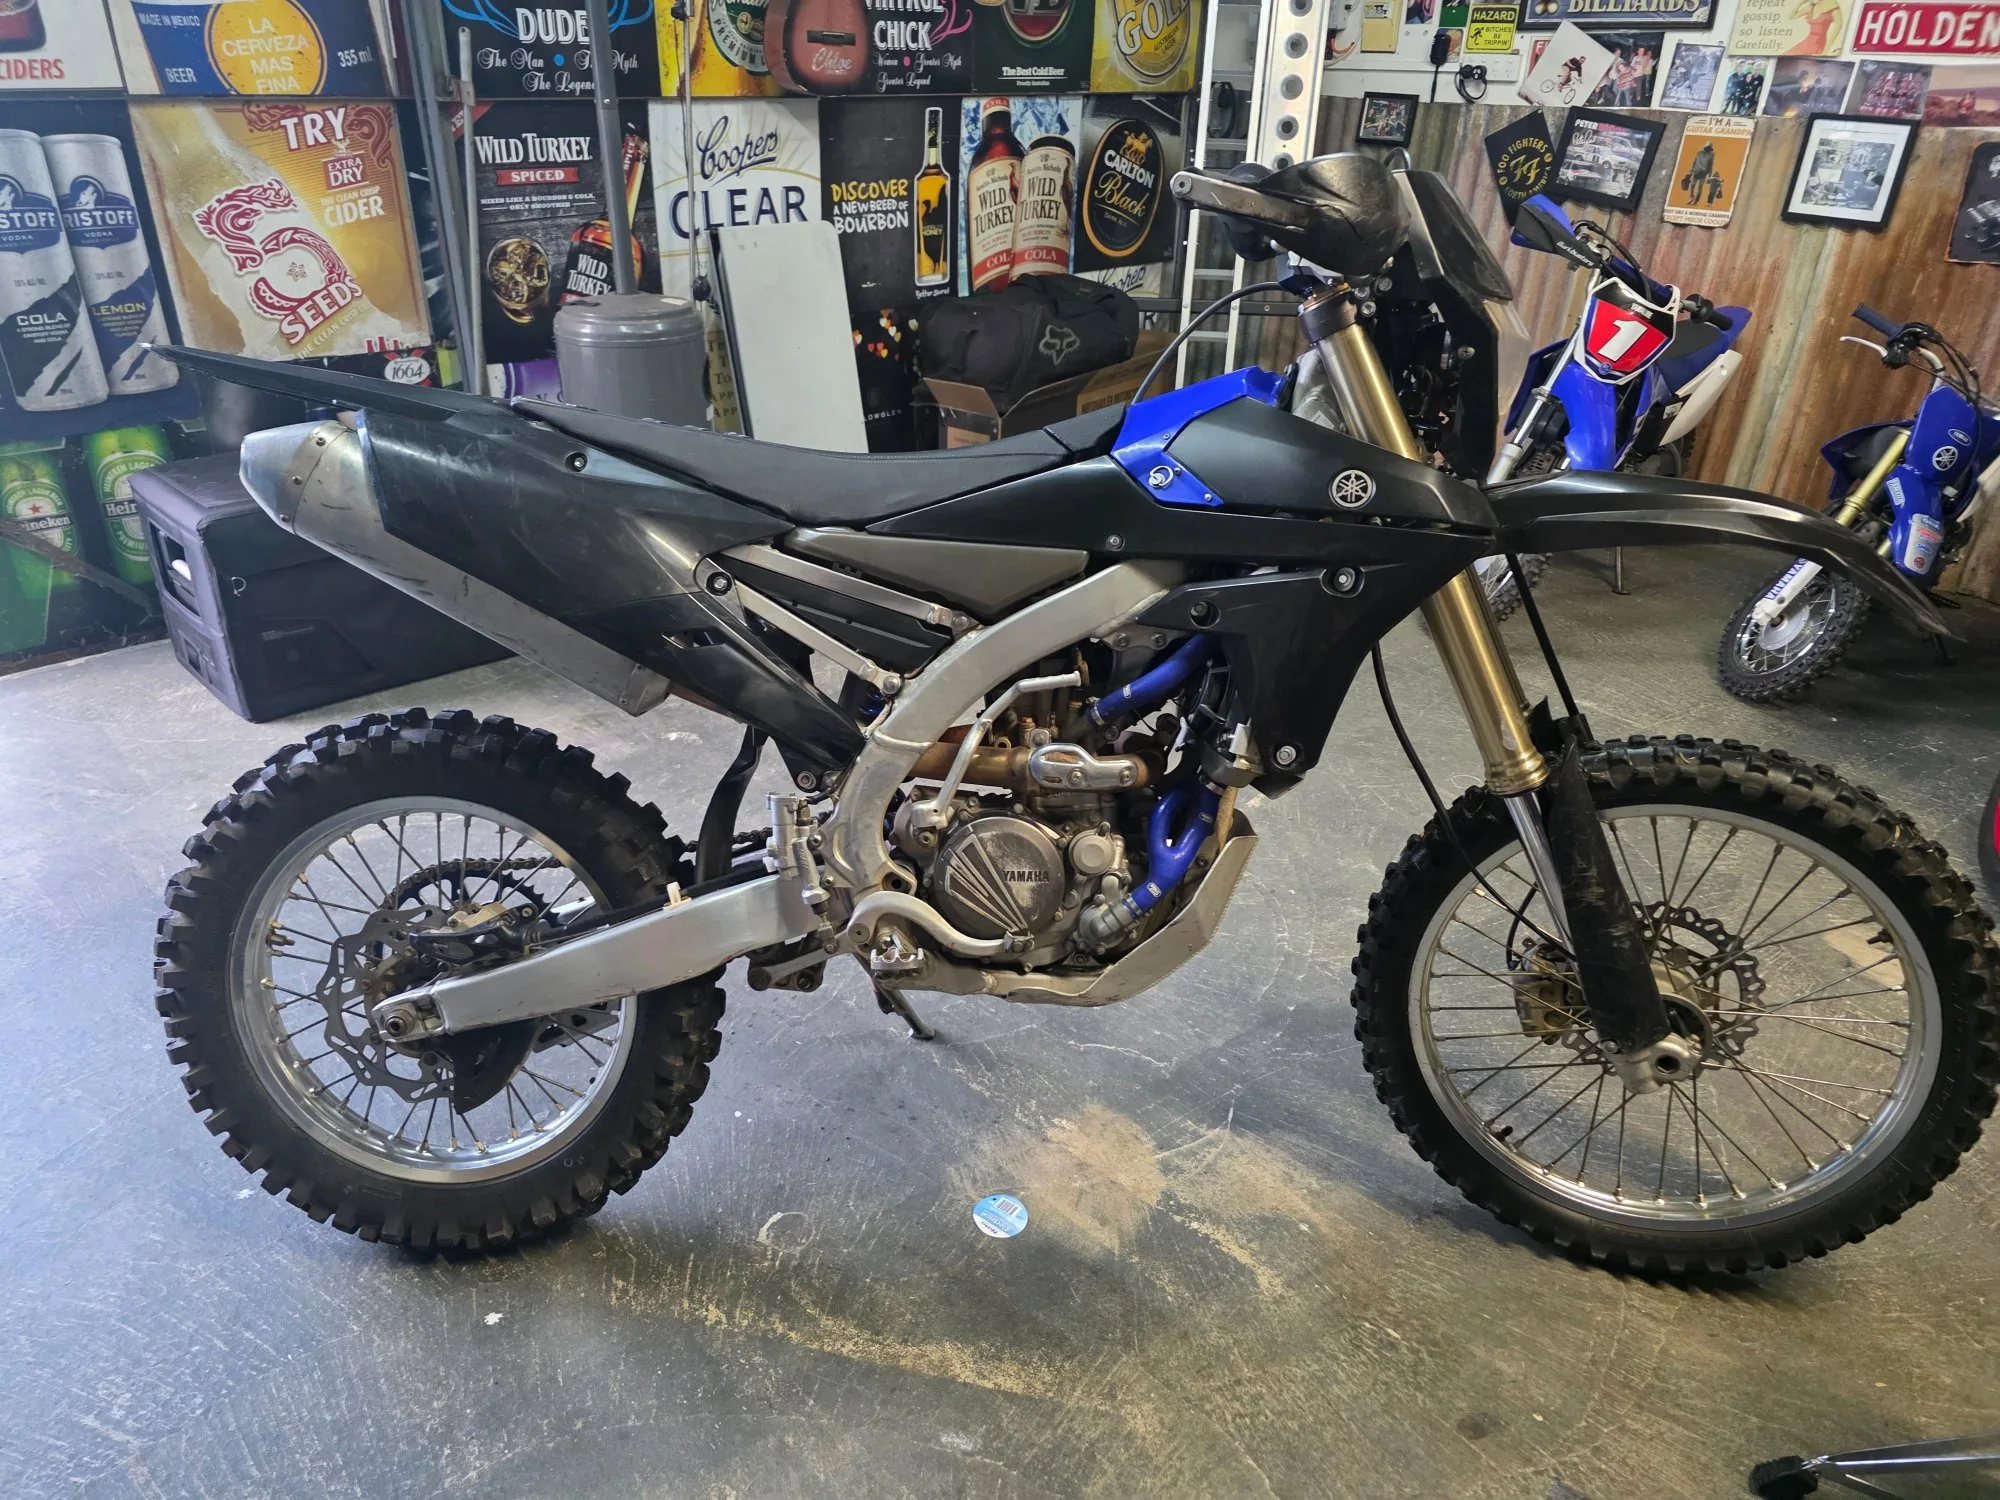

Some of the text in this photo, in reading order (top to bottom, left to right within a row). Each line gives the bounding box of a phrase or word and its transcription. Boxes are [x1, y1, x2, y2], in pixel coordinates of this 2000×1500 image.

[139, 13, 201, 27] MADE IN MEXICO
[248, 17, 275, 34] LA
[515, 7, 591, 44] DUDE
[1473, 11, 1515, 20] HAZARD
[874, 20, 933, 50] CHICK
[1117, 0, 1189, 56] GOL
[1739, 26, 1793, 36] so listen
[222, 33, 309, 57] CERVEZA
[251, 56, 294, 75] MAS
[337, 46, 373, 67] 355 ml
[477, 47, 544, 70] The Man
[165, 68, 197, 83] BEER
[522, 71, 551, 92] The
[1002, 67, 1065, 76] The Best Cold Beer
[256, 76, 300, 94] FINA
[279, 106, 347, 150] TRY
[1574, 119, 1598, 129] PETER
[1687, 125, 1752, 136] GUITAR GRANDPA
[1709, 117, 1732, 127] I'M A
[474, 135, 524, 164] WILD
[696, 116, 779, 183] Coopers
[1497, 138, 1548, 173] FOO FIGHTERS
[328, 157, 363, 171] EXTRA
[1104, 150, 1155, 188] CARLTON
[329, 165, 364, 187] DRY
[511, 170, 565, 183] SPICED
[1027, 176, 1056, 196] WILD
[336, 190, 359, 203] CLEAN
[831, 179, 908, 202] DISCOVER
[978, 187, 1007, 212] WILD
[1094, 170, 1150, 217] Black
[323, 196, 385, 228] CIDER
[669, 186, 808, 239] CLEAR
[833, 199, 909, 215] A NEW BREED OF
[1020, 199, 1061, 222] TURKEY
[0, 212, 57, 229] STOFF
[62, 210, 134, 227] RISTOFF
[834, 211, 909, 235] BOURBON
[974, 205, 1015, 237] TURKEY
[1024, 249, 1057, 260] COLA
[577, 254, 608, 280] WILD
[16, 312, 68, 326] COLA
[92, 302, 146, 316] LEMON
[279, 275, 363, 346] SEEDS
[314, 323, 338, 346] CLEAN
[1598, 319, 1648, 362] 1
[392, 364, 423, 379] 1664
[22, 516, 71, 531] ineken
[1764, 564, 1805, 600] YAMAHA
[1003, 870, 1049, 882] YAMAHA
